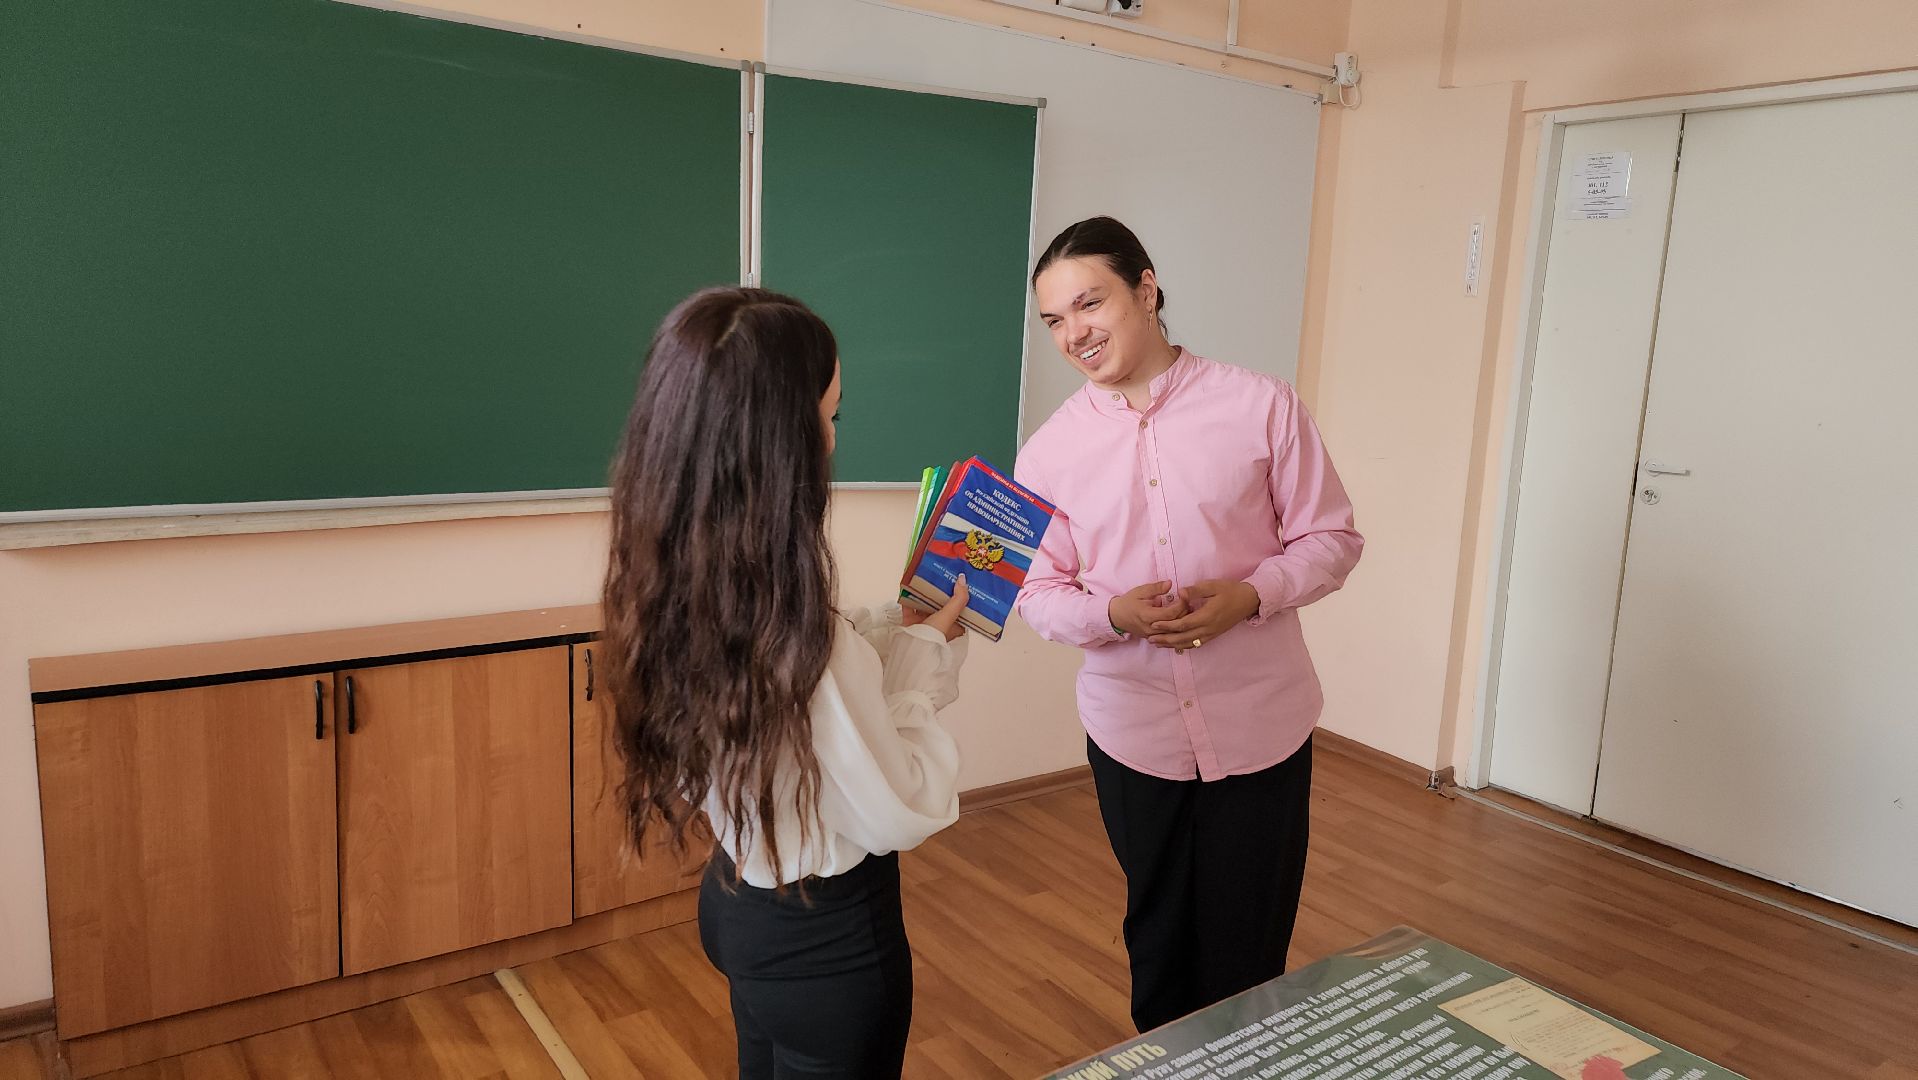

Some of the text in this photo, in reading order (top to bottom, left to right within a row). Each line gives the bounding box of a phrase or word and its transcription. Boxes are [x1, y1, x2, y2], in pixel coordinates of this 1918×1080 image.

[992, 488, 1022, 511] КОДЕКС
[967, 501, 1025, 541] ПРАВОНАРУШЕНИЯХ
[972, 496, 1035, 538] АДМИНИСТРАТИВНЫХ
[1144, 1063, 1174, 1079] Рузу
[1170, 1048, 1208, 1068] заняли
[1205, 1023, 1264, 1052] фашистские
[1317, 986, 1345, 1000] этому
[1380, 955, 1413, 971] области
[1212, 1030, 1278, 1064] партизанской
[1273, 1017, 1311, 1034] борьбе.
[1259, 1054, 1307, 1079] пытались
[1303, 1033, 1349, 1056] выведать
[1352, 1009, 1398, 1033] населения
[1393, 997, 1421, 1012] место
[1492, 1046, 1514, 1058] был
[1110, 1043, 1167, 1071] ПУТЬ
[1216, 1055, 1260, 1077] Солнцев
[1255, 1043, 1280, 1058] был
[1426, 1045, 1485, 1078] его товарищи
[1508, 1056, 1531, 1069] ему
